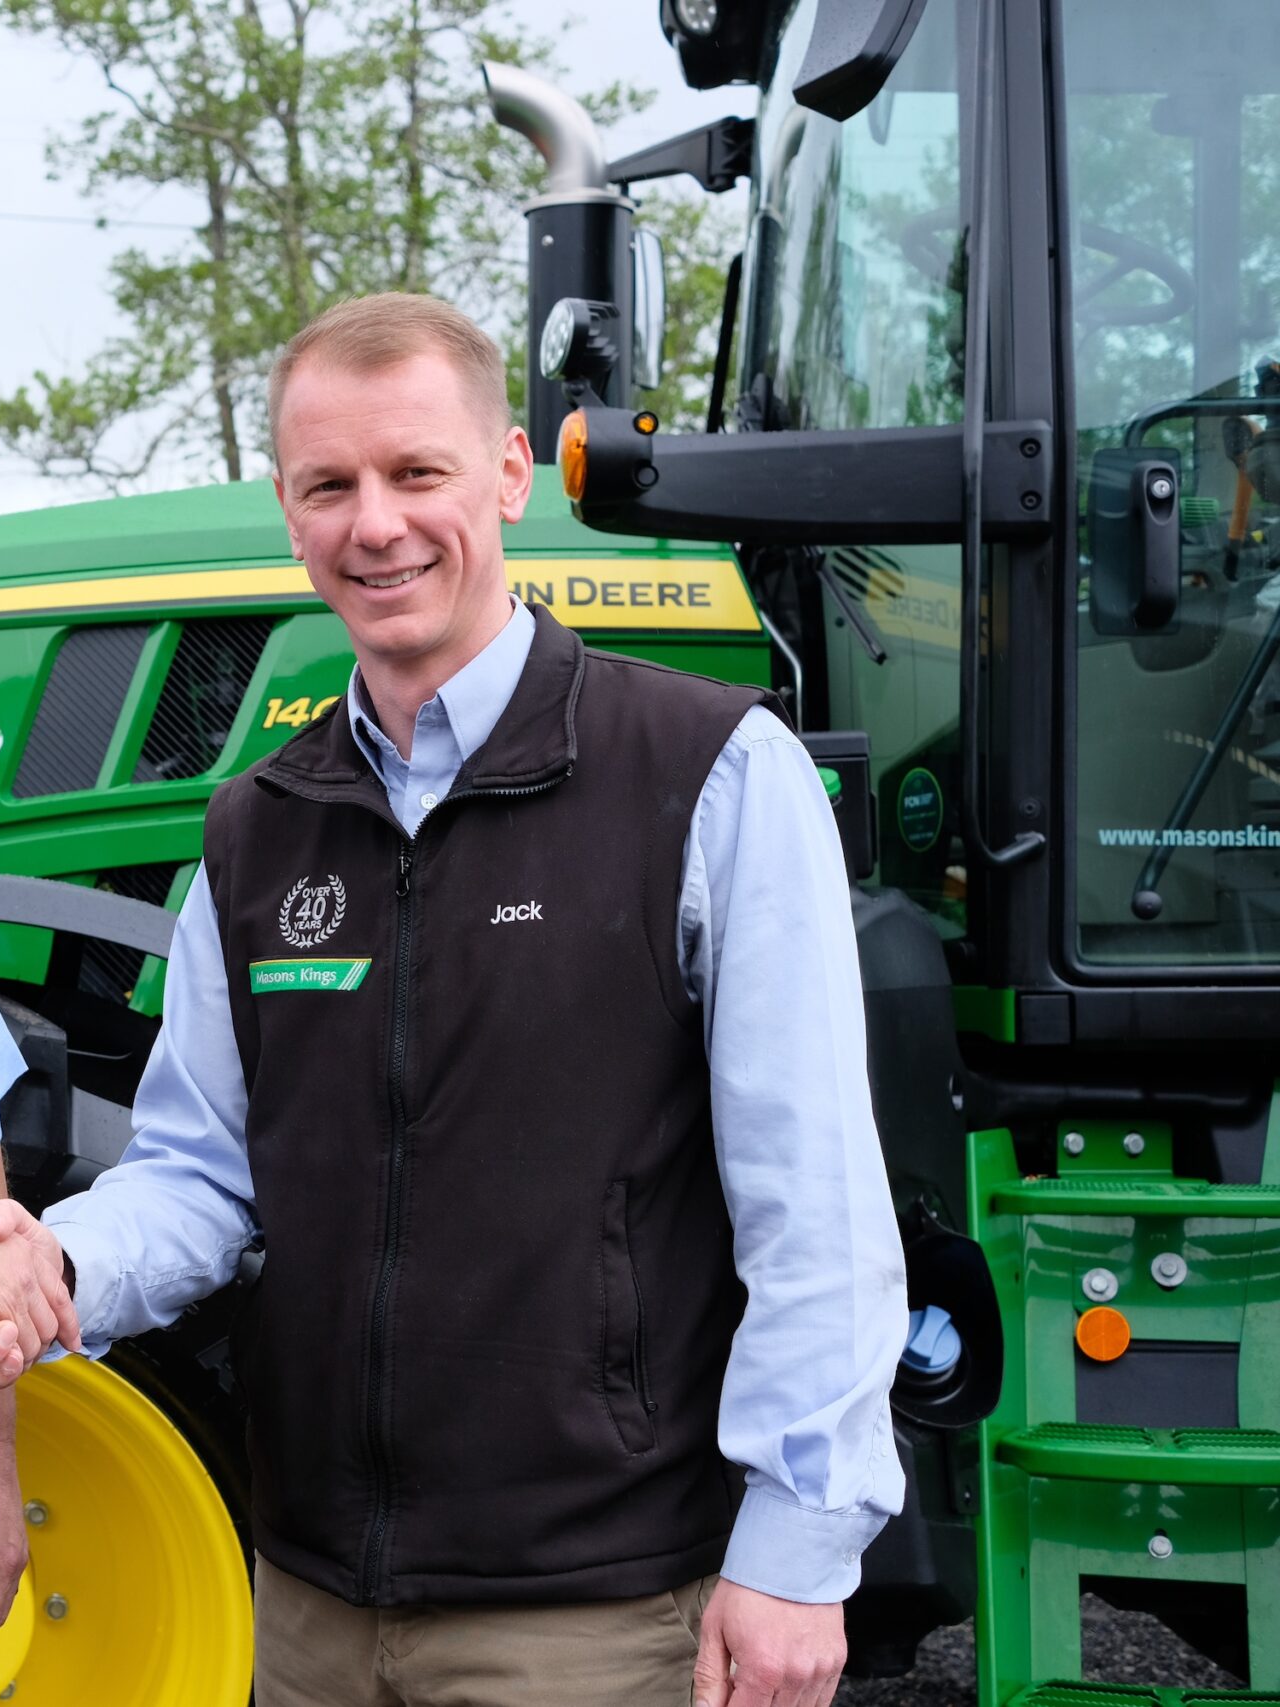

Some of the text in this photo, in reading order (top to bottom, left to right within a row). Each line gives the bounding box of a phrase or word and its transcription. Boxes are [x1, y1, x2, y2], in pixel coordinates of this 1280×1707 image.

[566, 576, 712, 607] DEERE
[302, 885, 331, 899] OVER
[295, 896, 327, 921] 40
[490, 900, 544, 925] Jack
[293, 919, 322, 931] YEARS
[256, 966, 338, 986] Masons Kings
